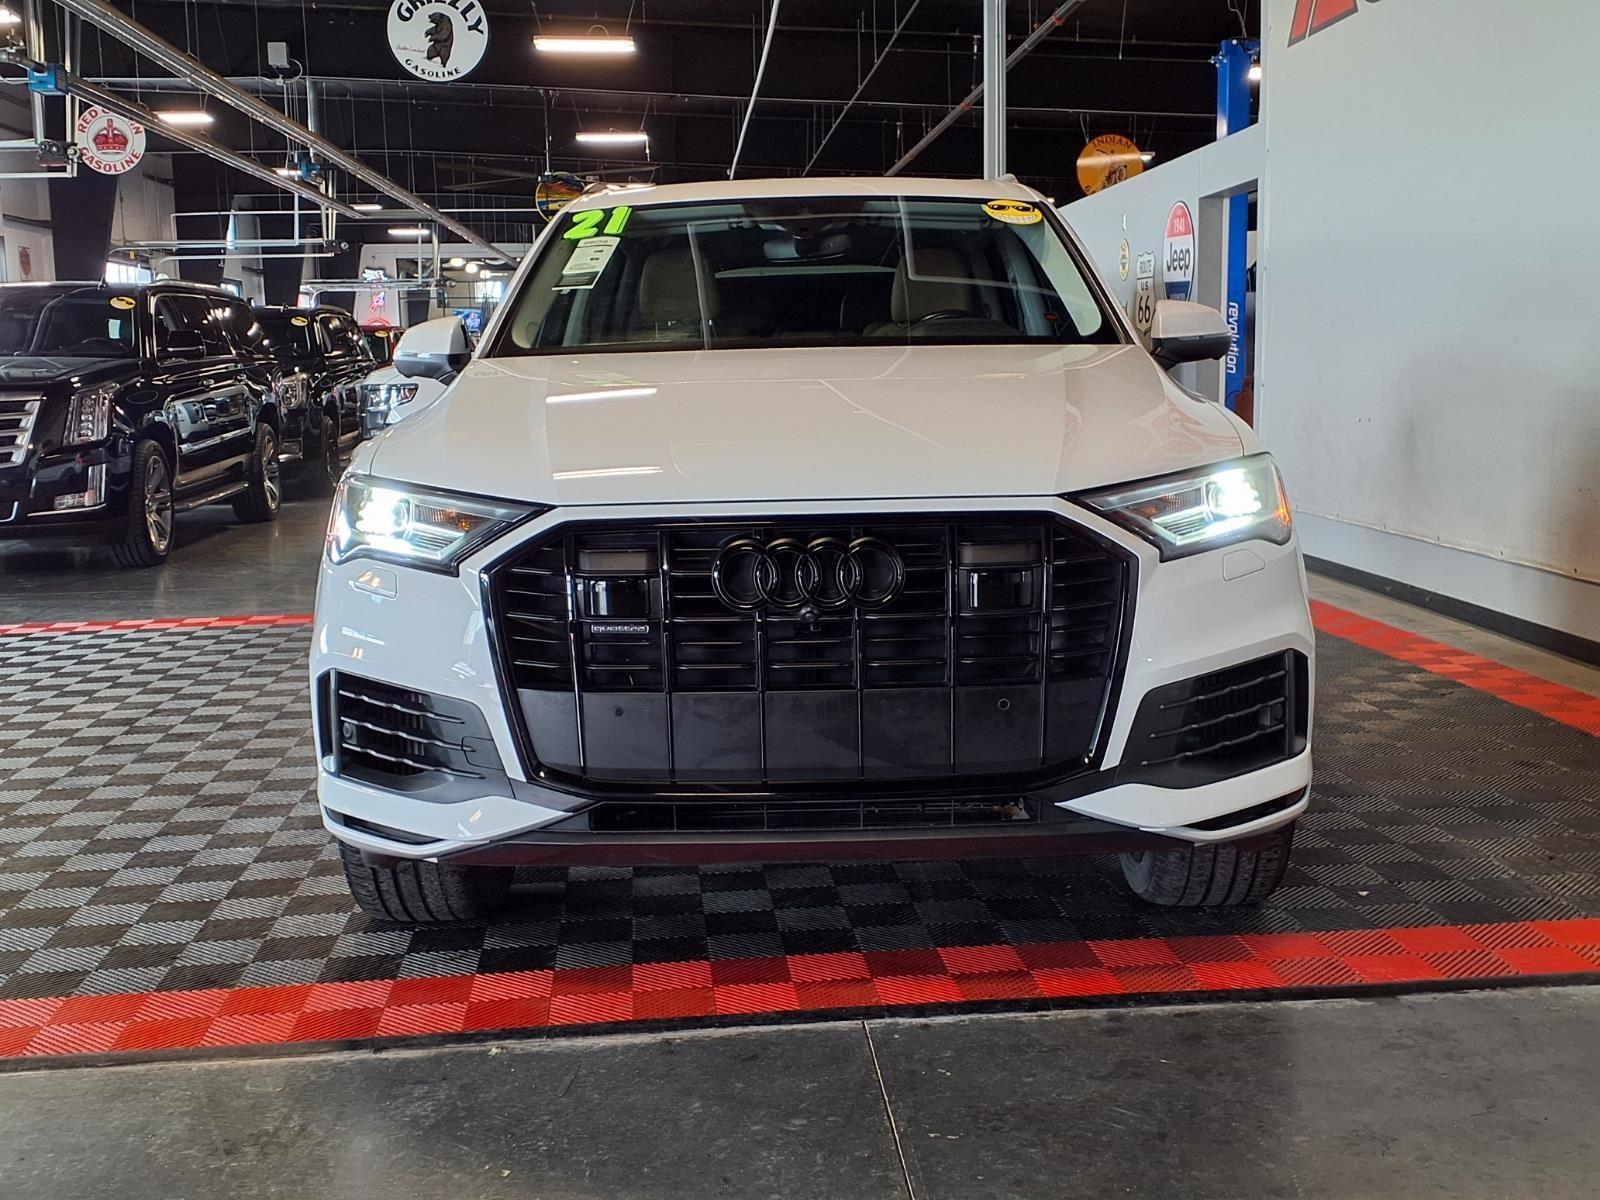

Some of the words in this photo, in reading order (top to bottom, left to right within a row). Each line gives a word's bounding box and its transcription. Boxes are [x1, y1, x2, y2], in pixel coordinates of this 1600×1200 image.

[396, 0, 484, 35] GRZLY
[405, 58, 462, 78] GASOLINE
[77, 109, 99, 134] RED
[1092, 136, 1134, 150] INDIAN
[80, 147, 141, 173] GASOLINE
[563, 206, 632, 239] 21
[1167, 242, 1191, 277] Jeep
[1138, 295, 1151, 324] 66
[1226, 302, 1240, 374] revolution
[593, 624, 646, 633] quattro
